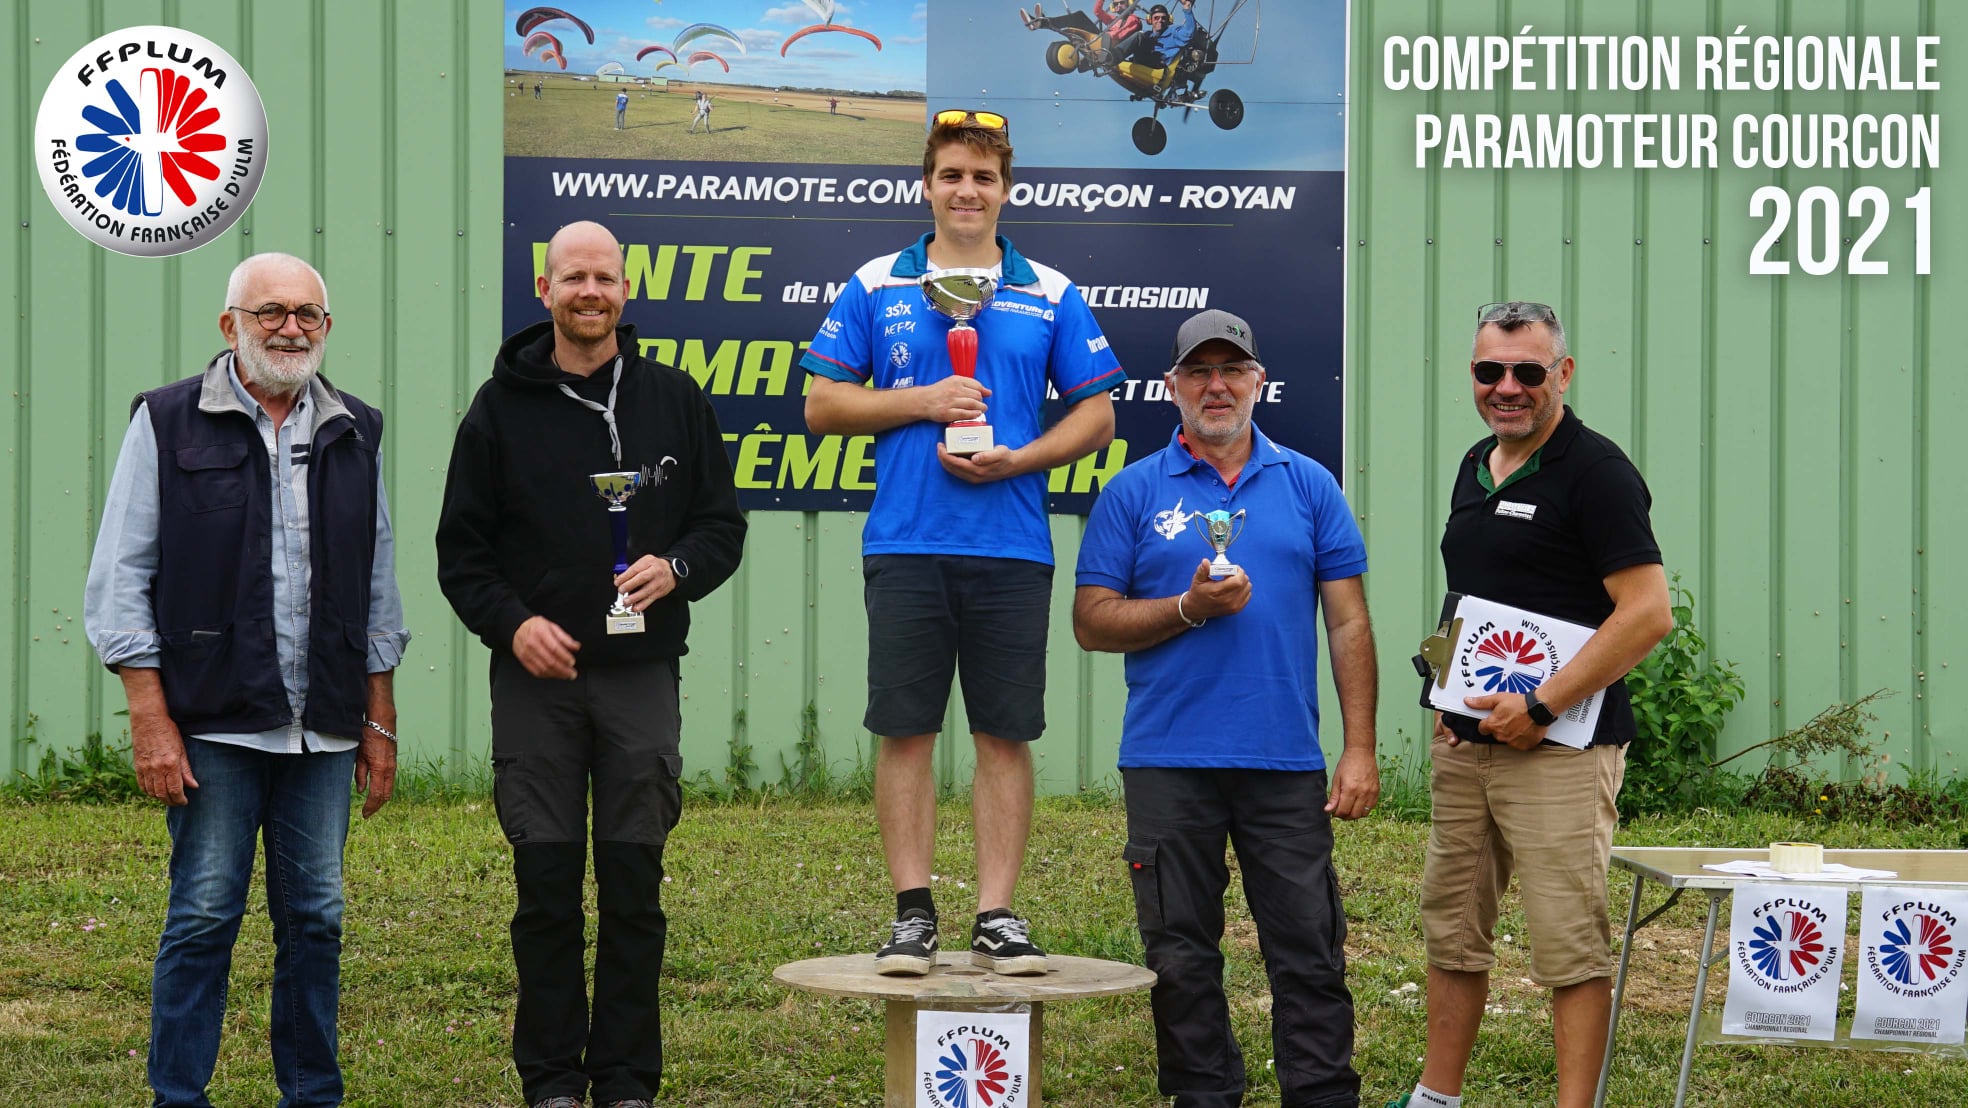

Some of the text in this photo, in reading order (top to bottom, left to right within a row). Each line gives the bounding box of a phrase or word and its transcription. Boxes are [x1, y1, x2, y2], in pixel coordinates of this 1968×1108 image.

[552, 172, 923, 205] WWW.PARAMOTE.COM
[1009, 183, 1153, 212] OURÇON
[1180, 185, 1296, 210] ROYAN
[782, 281, 819, 303] de
[1461, 621, 1496, 689] FFPLUM
[1753, 898, 1828, 923] FFPLUM
[1882, 901, 1957, 927] FFPLUM
[1737, 941, 1838, 993] FÉDÉRATION FRANÇAISE D'ULM
[1867, 946, 1968, 998] FÉDÉRATION FRANÇAISE D'ULM
[1787, 1014, 1811, 1027] 2021
[1917, 1018, 1941, 1031] 2021
[937, 1025, 1010, 1050] FFPLUM
[1008, 1074, 1022, 1103] D'ULM
